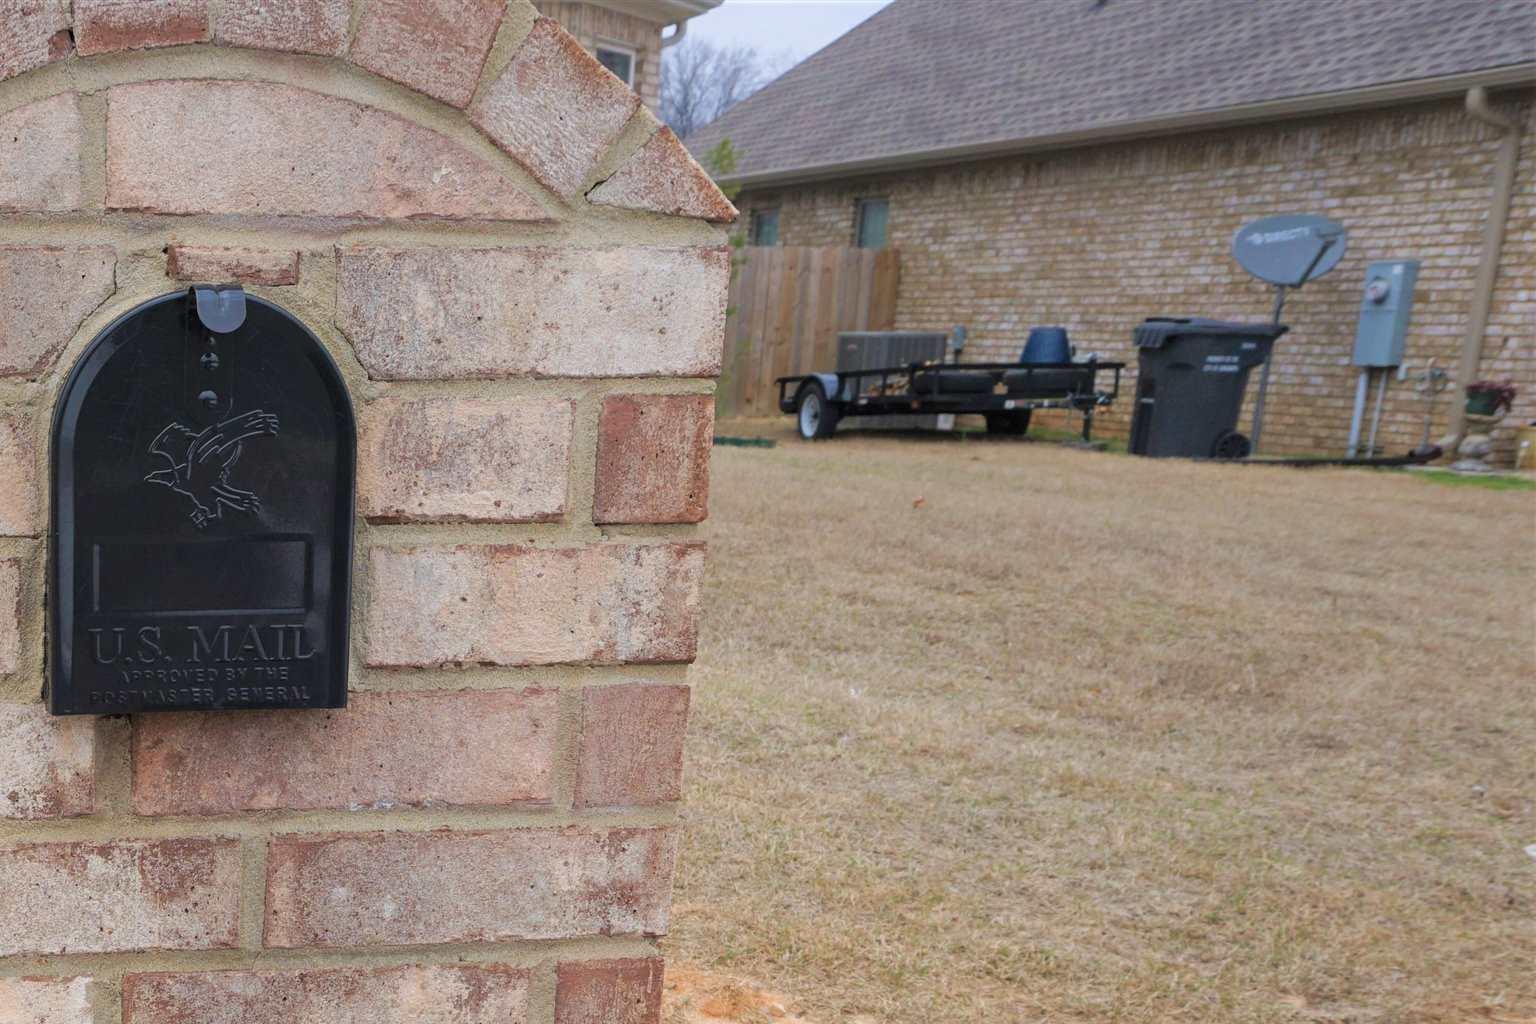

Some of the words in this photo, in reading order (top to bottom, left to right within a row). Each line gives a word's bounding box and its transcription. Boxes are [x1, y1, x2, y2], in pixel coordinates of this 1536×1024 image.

[87, 626, 173, 664] U.S.
[186, 624, 317, 662] MAIL
[120, 668, 218, 684] APPROVED
[224, 667, 248, 681] BY
[253, 666, 289, 680] THE
[226, 685, 311, 701] GENERAL
